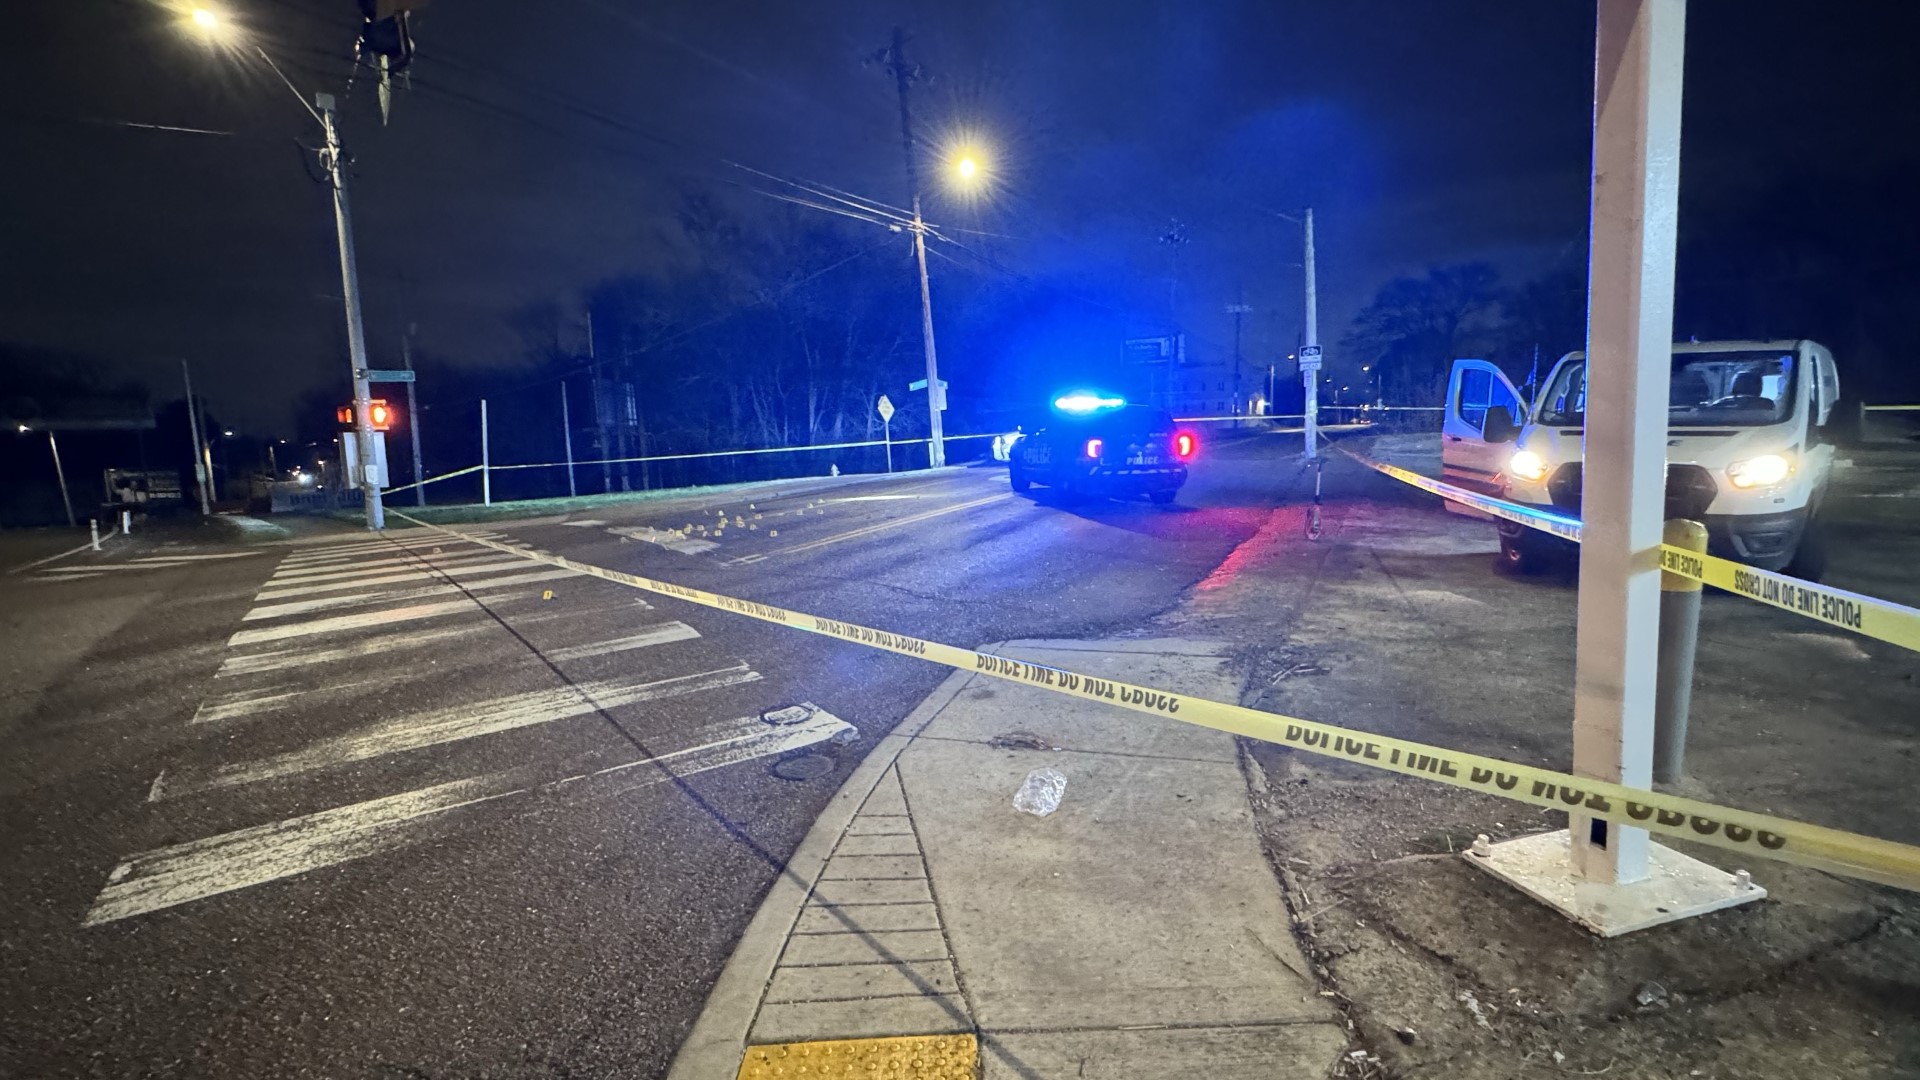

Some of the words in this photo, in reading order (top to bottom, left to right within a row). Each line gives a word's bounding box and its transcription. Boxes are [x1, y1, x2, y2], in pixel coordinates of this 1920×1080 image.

[1126, 456, 1159, 465] POLICE
[1667, 551, 1680, 572] LINE
[1681, 554, 1703, 578] POLICE
[1734, 569, 1761, 595] CROSS
[1762, 576, 1780, 602] NOT
[1781, 583, 1796, 608] DO
[1798, 587, 1819, 616] LINE
[1822, 594, 1862, 629] POLICE
